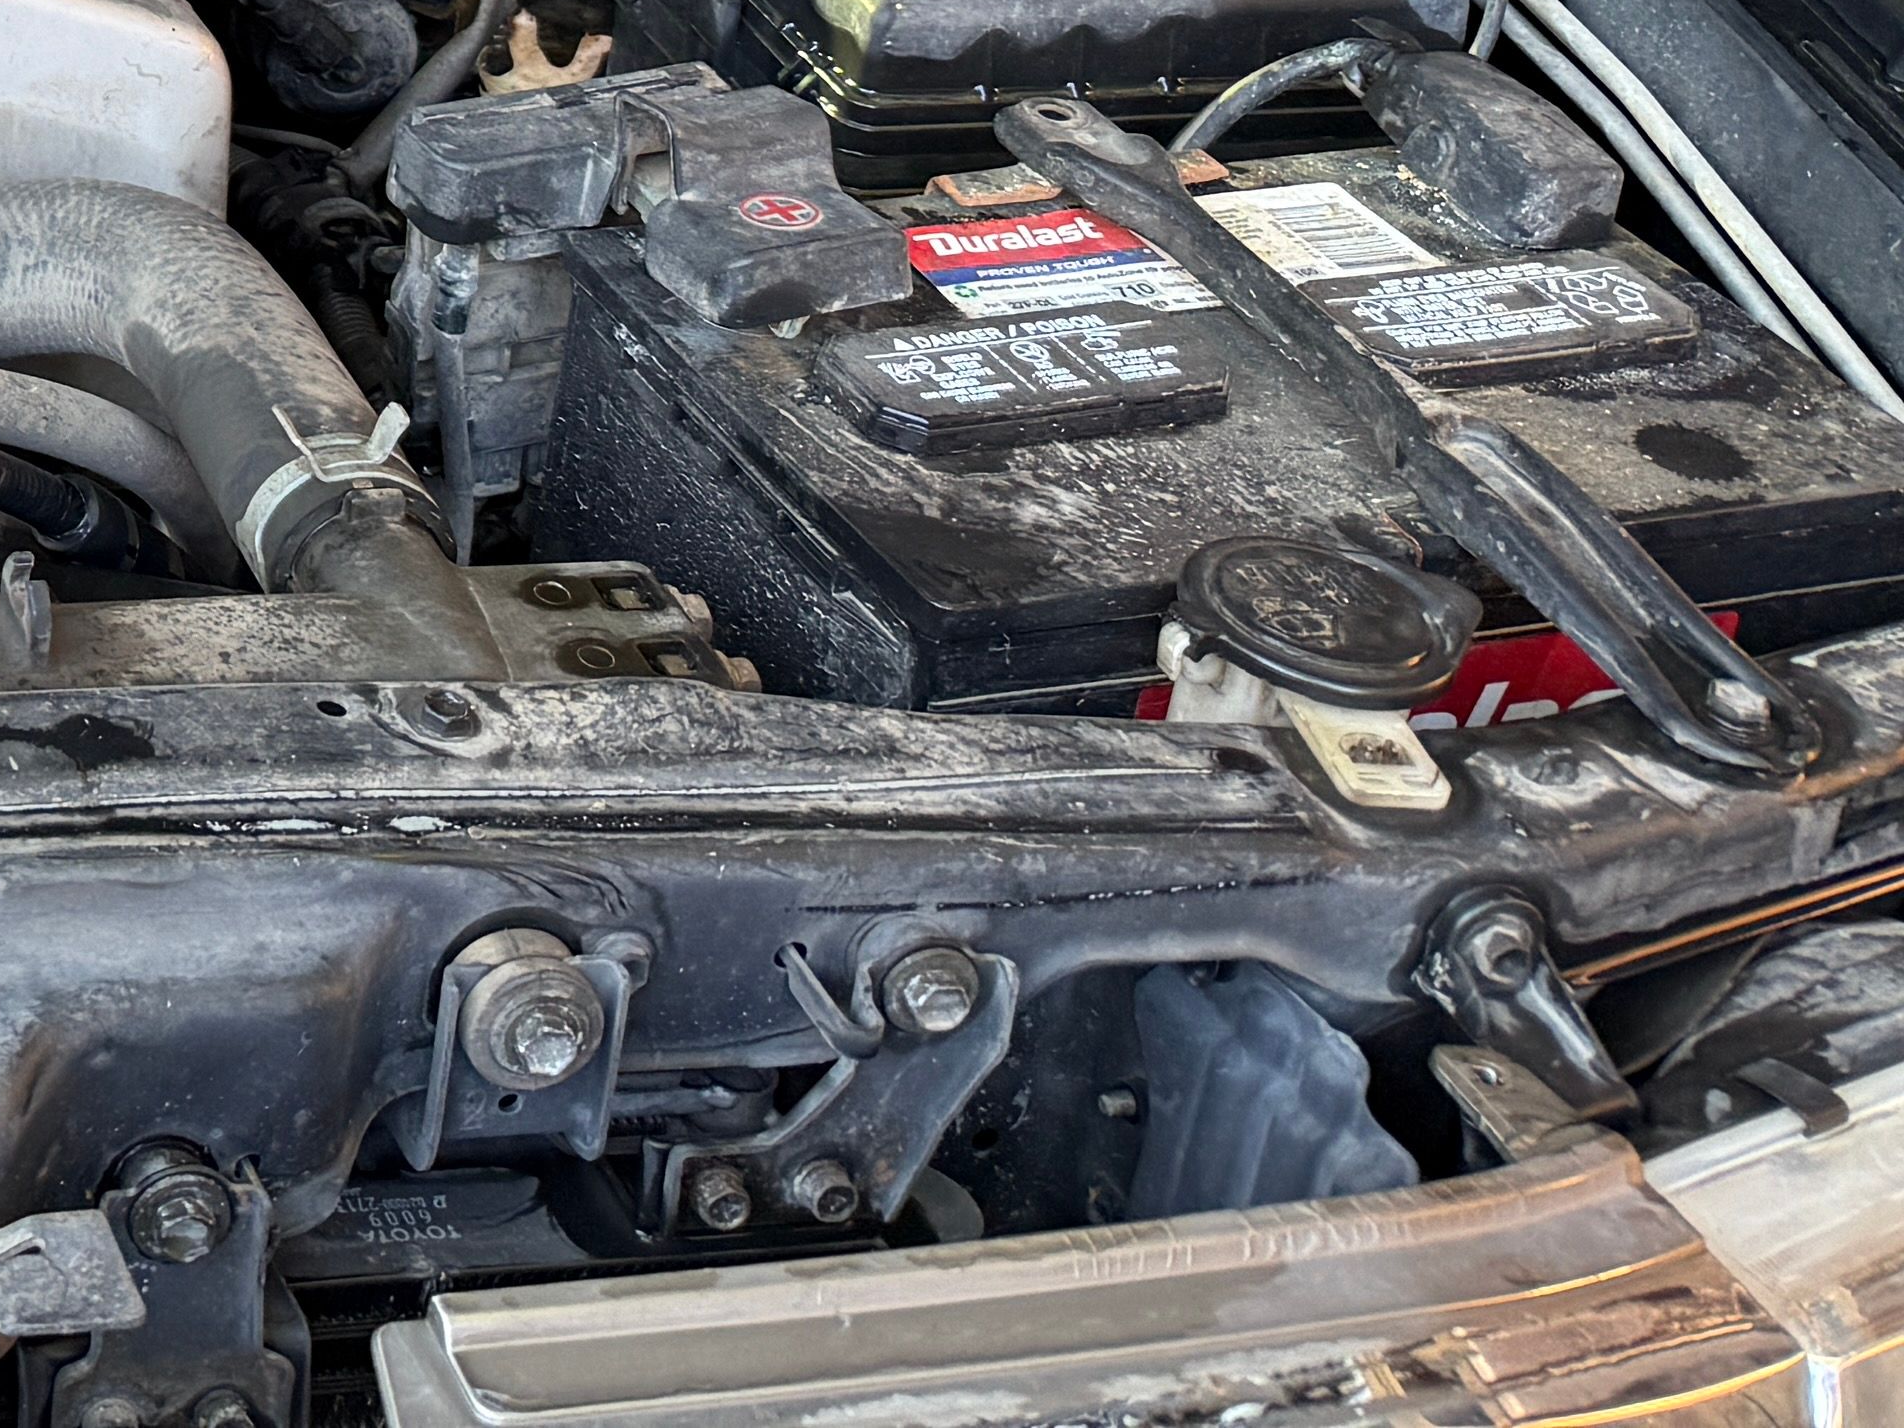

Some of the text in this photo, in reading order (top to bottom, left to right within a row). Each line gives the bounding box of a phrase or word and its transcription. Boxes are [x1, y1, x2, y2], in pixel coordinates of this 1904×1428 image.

[912, 216, 1104, 257] Duralast
[976, 264, 1050, 278] PROVEN
[1111, 282, 1156, 298] 710
[911, 325, 1000, 351] DANGER
[1026, 313, 1107, 337] POISON
[368, 1208, 432, 1228] 6009
[357, 1224, 463, 1244] TOYOTA
